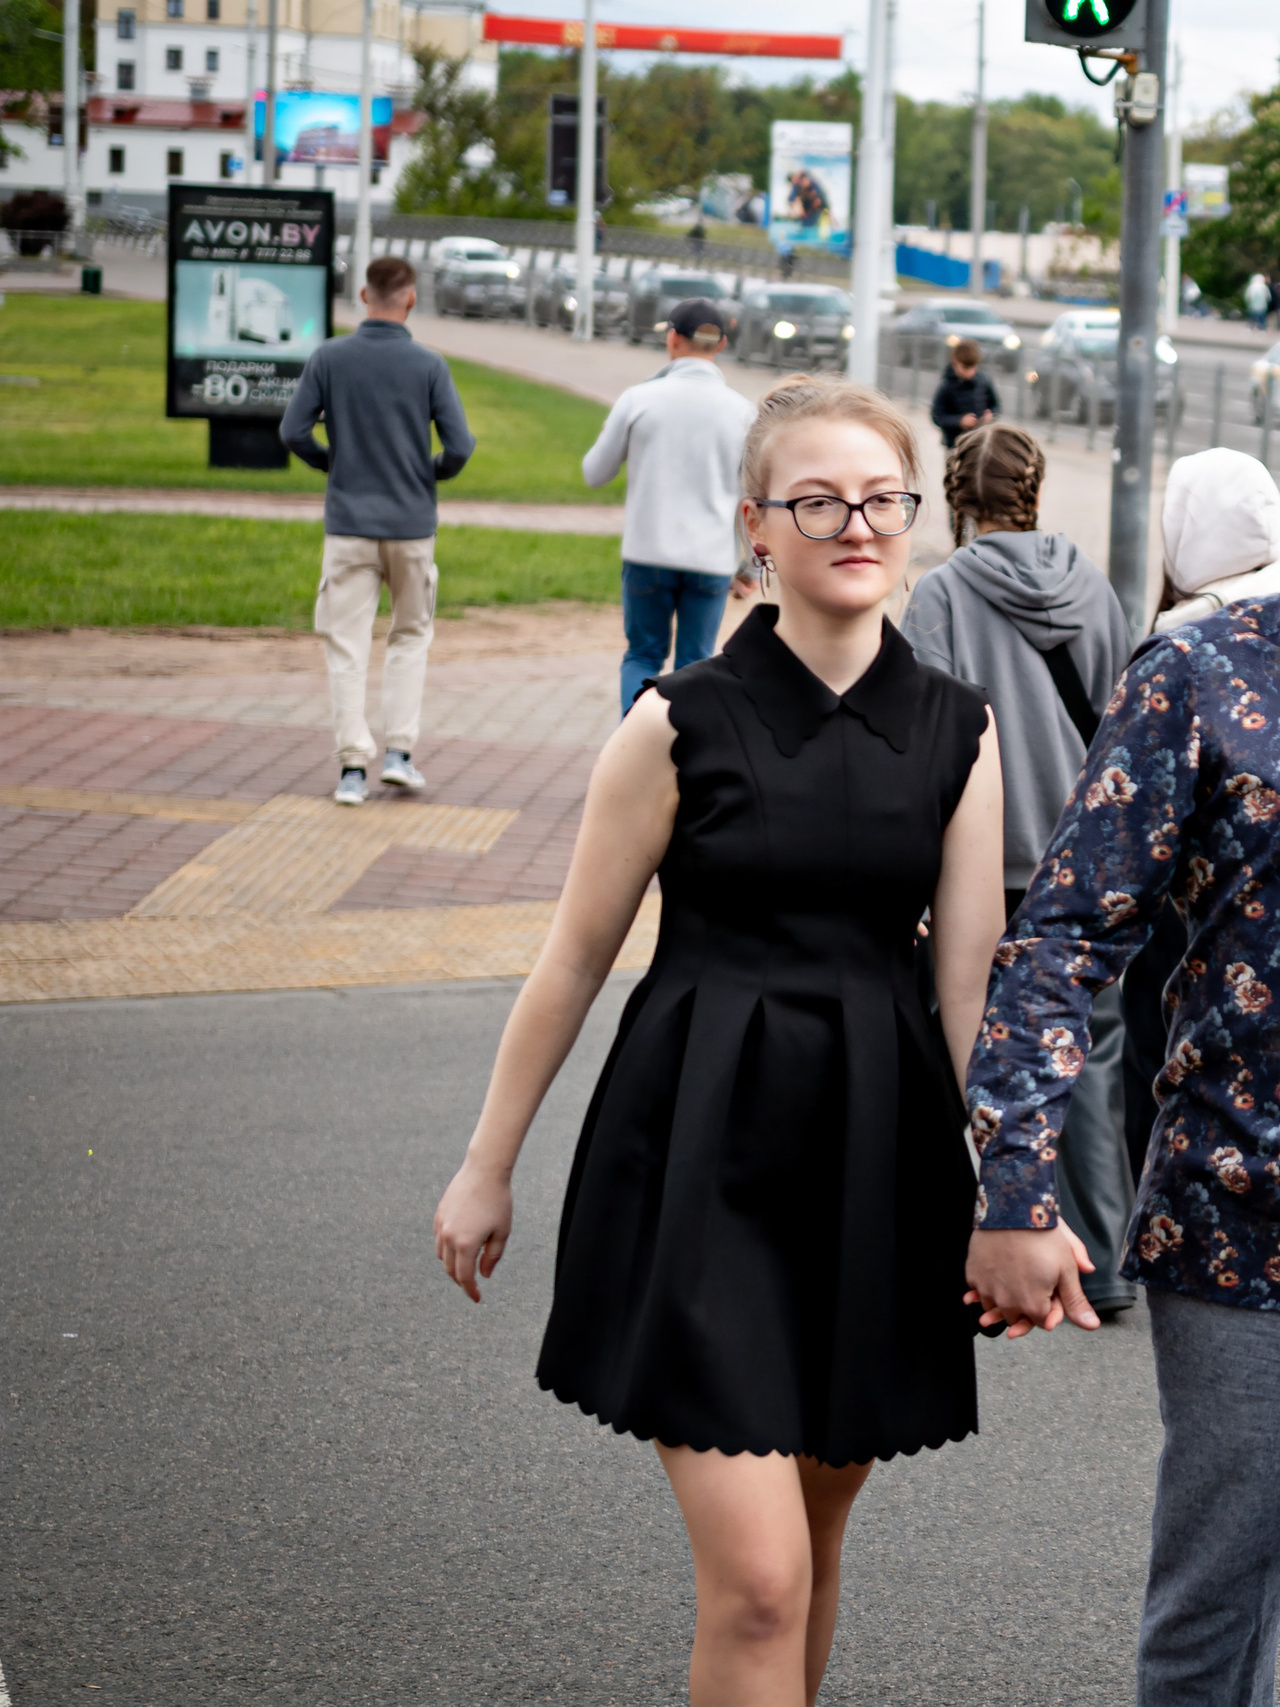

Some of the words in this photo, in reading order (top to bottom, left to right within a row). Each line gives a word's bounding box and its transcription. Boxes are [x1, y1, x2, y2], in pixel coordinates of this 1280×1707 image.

[183, 219, 320, 247] AVON.BY
[206, 360, 276, 374] ПОДАРКИ
[257, 377, 300, 391] АКЦИ
[250, 388, 296, 403] СКИД
